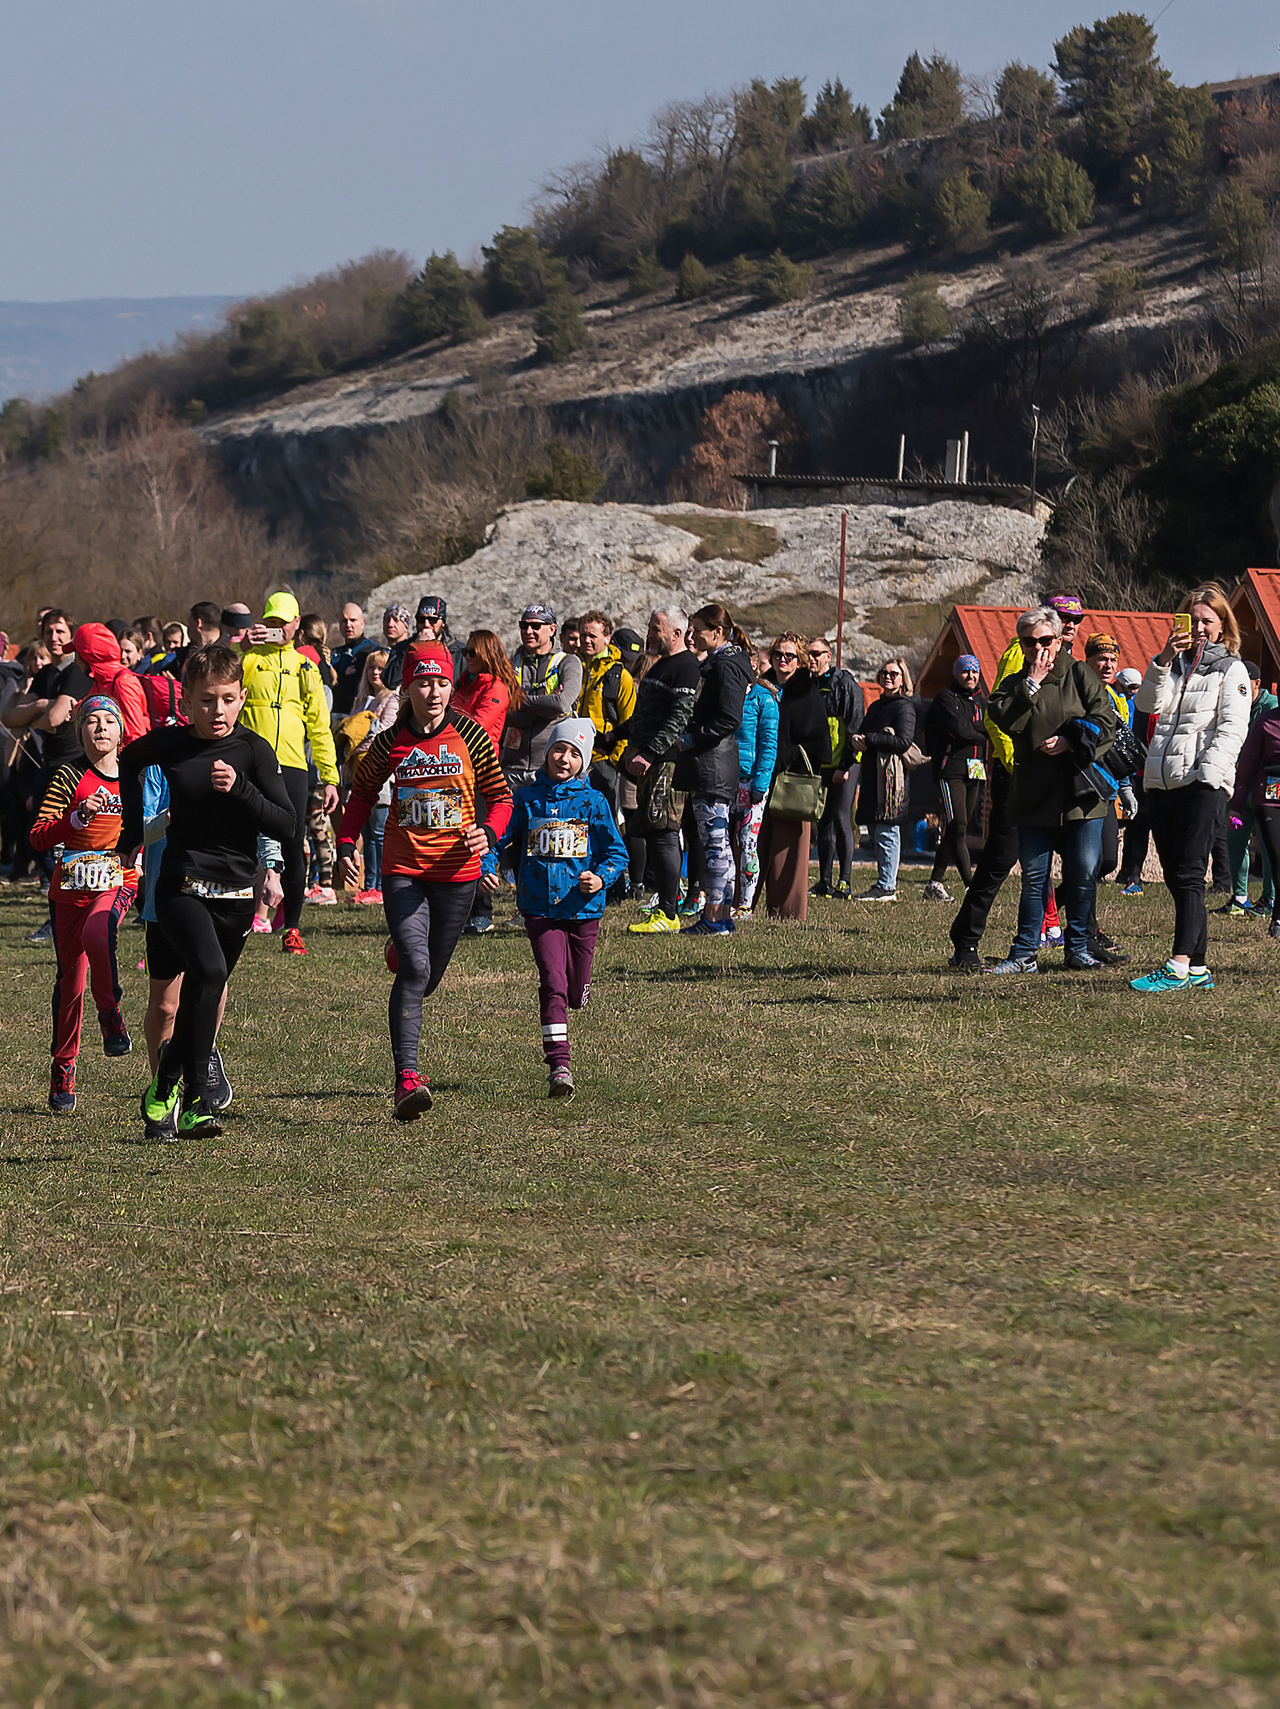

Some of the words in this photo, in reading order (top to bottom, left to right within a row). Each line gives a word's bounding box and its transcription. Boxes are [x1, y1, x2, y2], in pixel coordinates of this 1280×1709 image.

[412, 799, 445, 827] 011
[540, 829, 575, 855] 010
[74, 862, 111, 889] 006
